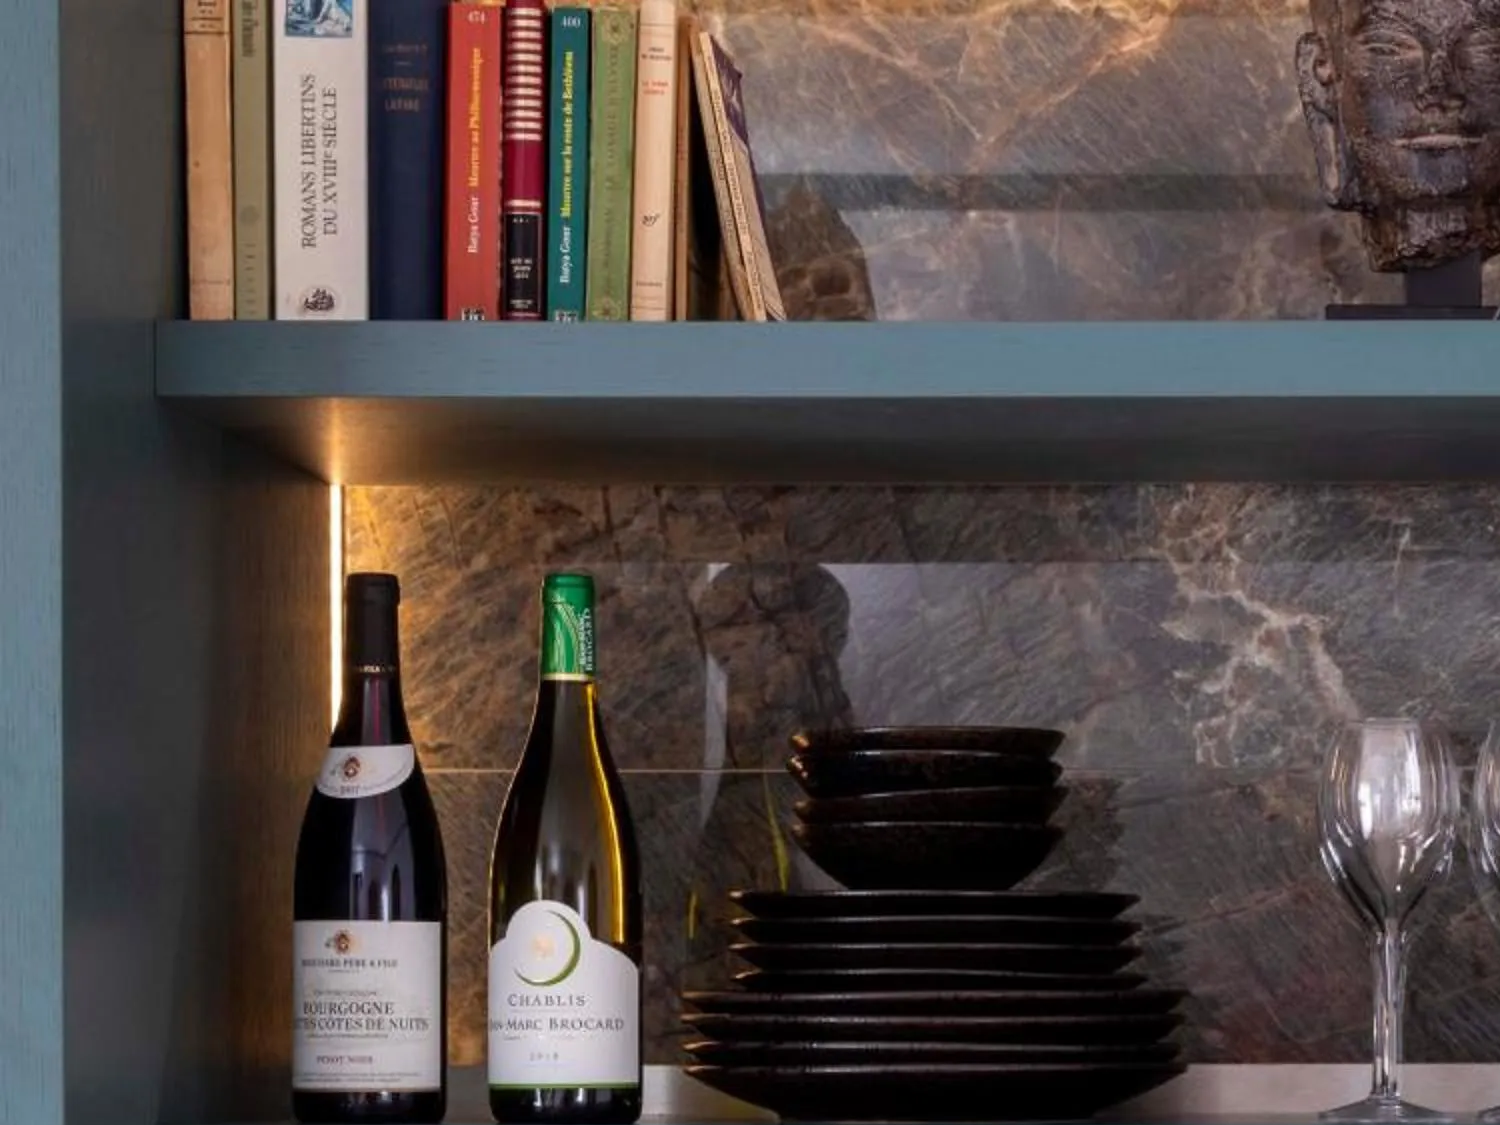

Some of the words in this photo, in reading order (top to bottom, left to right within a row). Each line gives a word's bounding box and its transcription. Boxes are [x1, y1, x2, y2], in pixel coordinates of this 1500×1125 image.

[301, 74, 316, 166] LIBERTINS
[301, 171, 317, 249] ROMANS
[323, 208, 337, 235] DU
[507, 994, 586, 1007] CHABLIS
[303, 1001, 394, 1015] BOURGOGNE
[365, 1018, 384, 1031] DE
[549, 1018, 625, 1031] BROCARD
